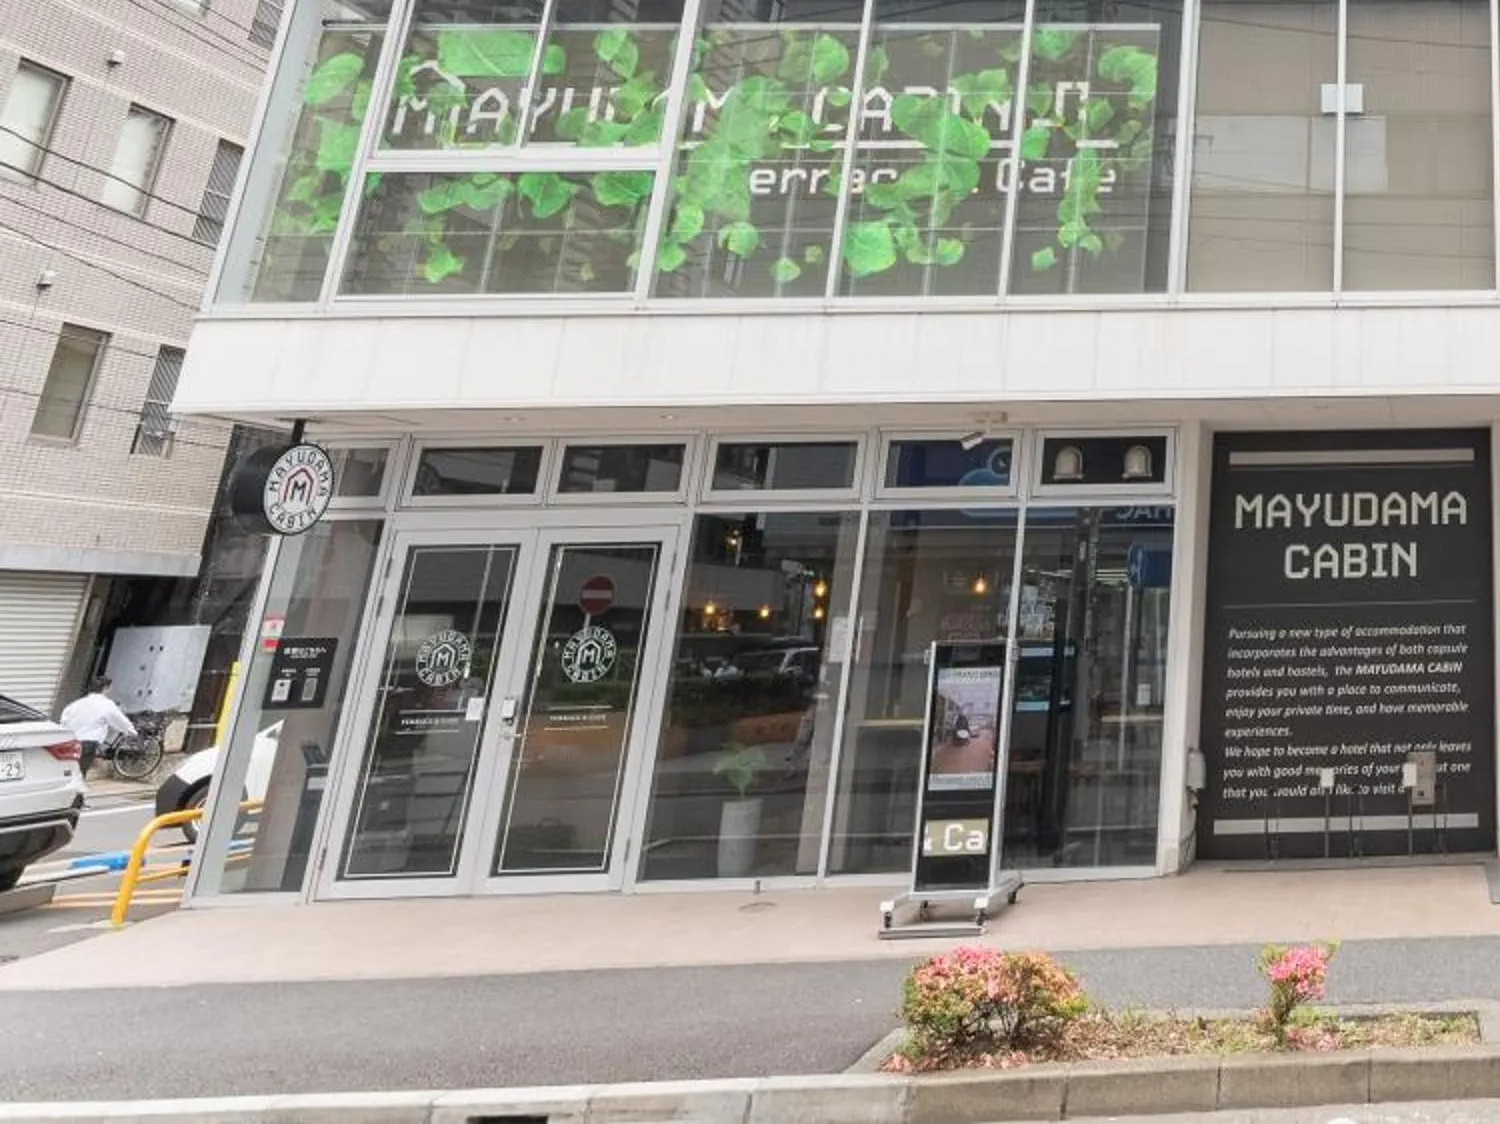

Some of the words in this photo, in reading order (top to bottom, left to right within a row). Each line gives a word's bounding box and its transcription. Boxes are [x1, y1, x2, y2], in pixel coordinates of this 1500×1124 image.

[1234, 491, 1468, 529] MAYUDAMA
[1283, 541, 1418, 580] CABIN
[1443, 623, 1467, 635] that
[1299, 644, 1318, 657] the
[1399, 642, 1425, 655] both
[1263, 665, 1285, 677] and
[1355, 662, 1425, 675] MAYUDAMA
[1427, 660, 1463, 673] CABIN
[1225, 684, 1274, 700] provides
[1276, 687, 1297, 699] you
[1299, 683, 1325, 696] with
[1337, 683, 1367, 698] place
[1355, 701, 1377, 714] and
[1379, 701, 1405, 714] have
[1407, 699, 1469, 713] memorable
[1244, 745, 1271, 759] hope
[1287, 743, 1329, 757] become
[1340, 741, 1369, 756] hotel
[1369, 740, 1392, 754] that
[1223, 767, 1245, 781] you
[1247, 764, 1271, 778] with
[1273, 763, 1303, 779] good
[1305, 762, 1359, 776] meories
[1361, 760, 1375, 777] of
[1375, 762, 1400, 776] your
